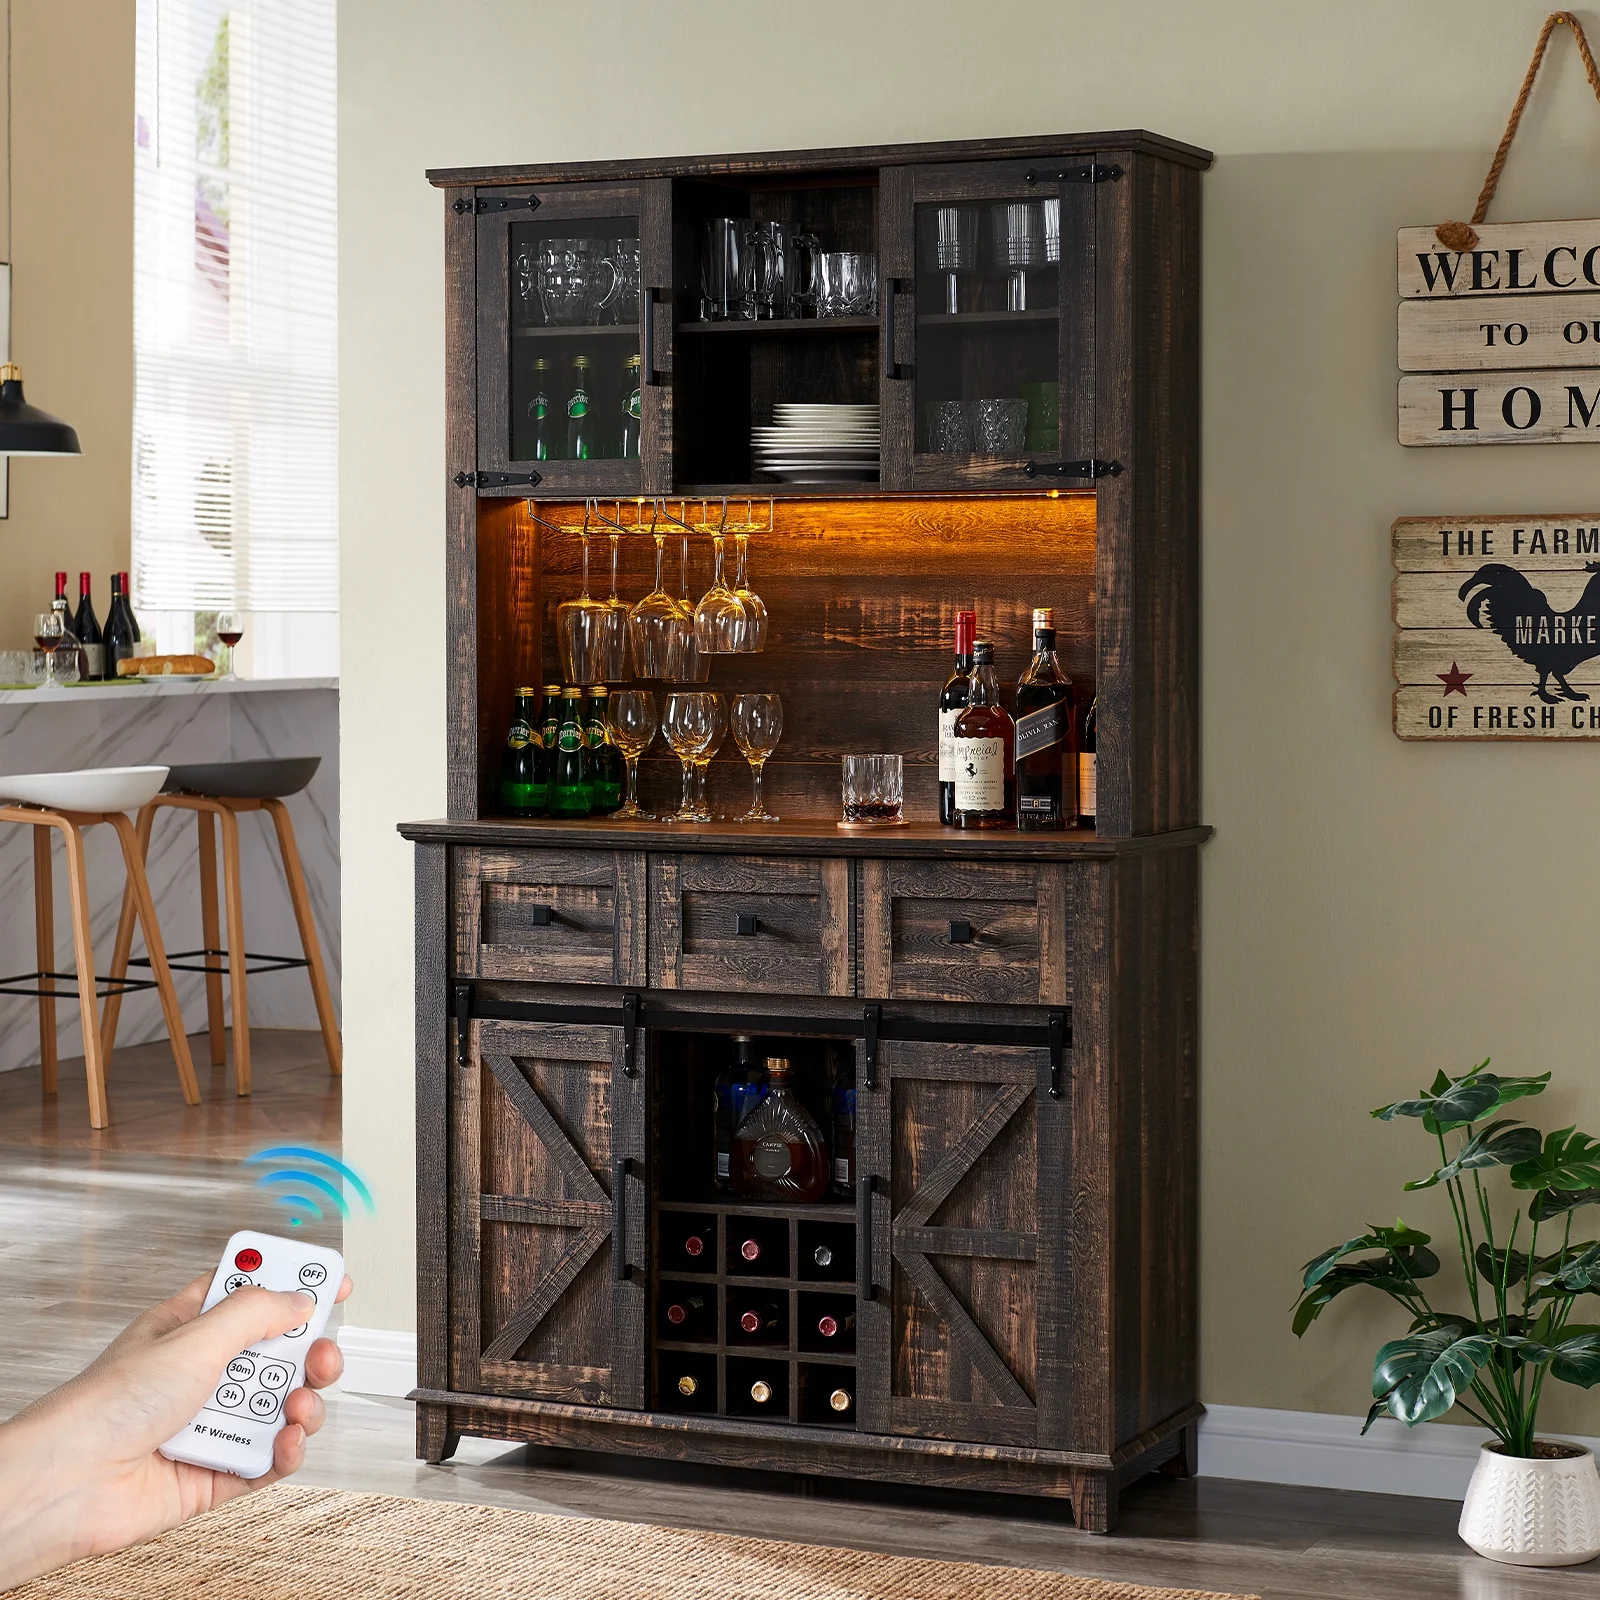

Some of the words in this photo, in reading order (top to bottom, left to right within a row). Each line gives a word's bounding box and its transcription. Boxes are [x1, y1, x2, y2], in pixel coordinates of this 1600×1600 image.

[1480, 323, 1529, 346] TO
[1438, 386, 1600, 431] HOM
[1438, 529, 1494, 556] THE
[1513, 528, 1599, 555] FARM
[1515, 615, 1596, 644] MARKE
[1428, 706, 1458, 728] OF
[1473, 706, 1555, 728] FRESH
[239, 1254, 259, 1265] ON
[302, 1268, 324, 1280] OFF
[230, 1363, 251, 1375] 30m
[267, 1371, 280, 1382] 1h
[223, 1389, 237, 1400] 3h
[256, 1398, 271, 1408] 4h
[194, 1424, 208, 1434] RF
[209, 1427, 252, 1446] Wireless
